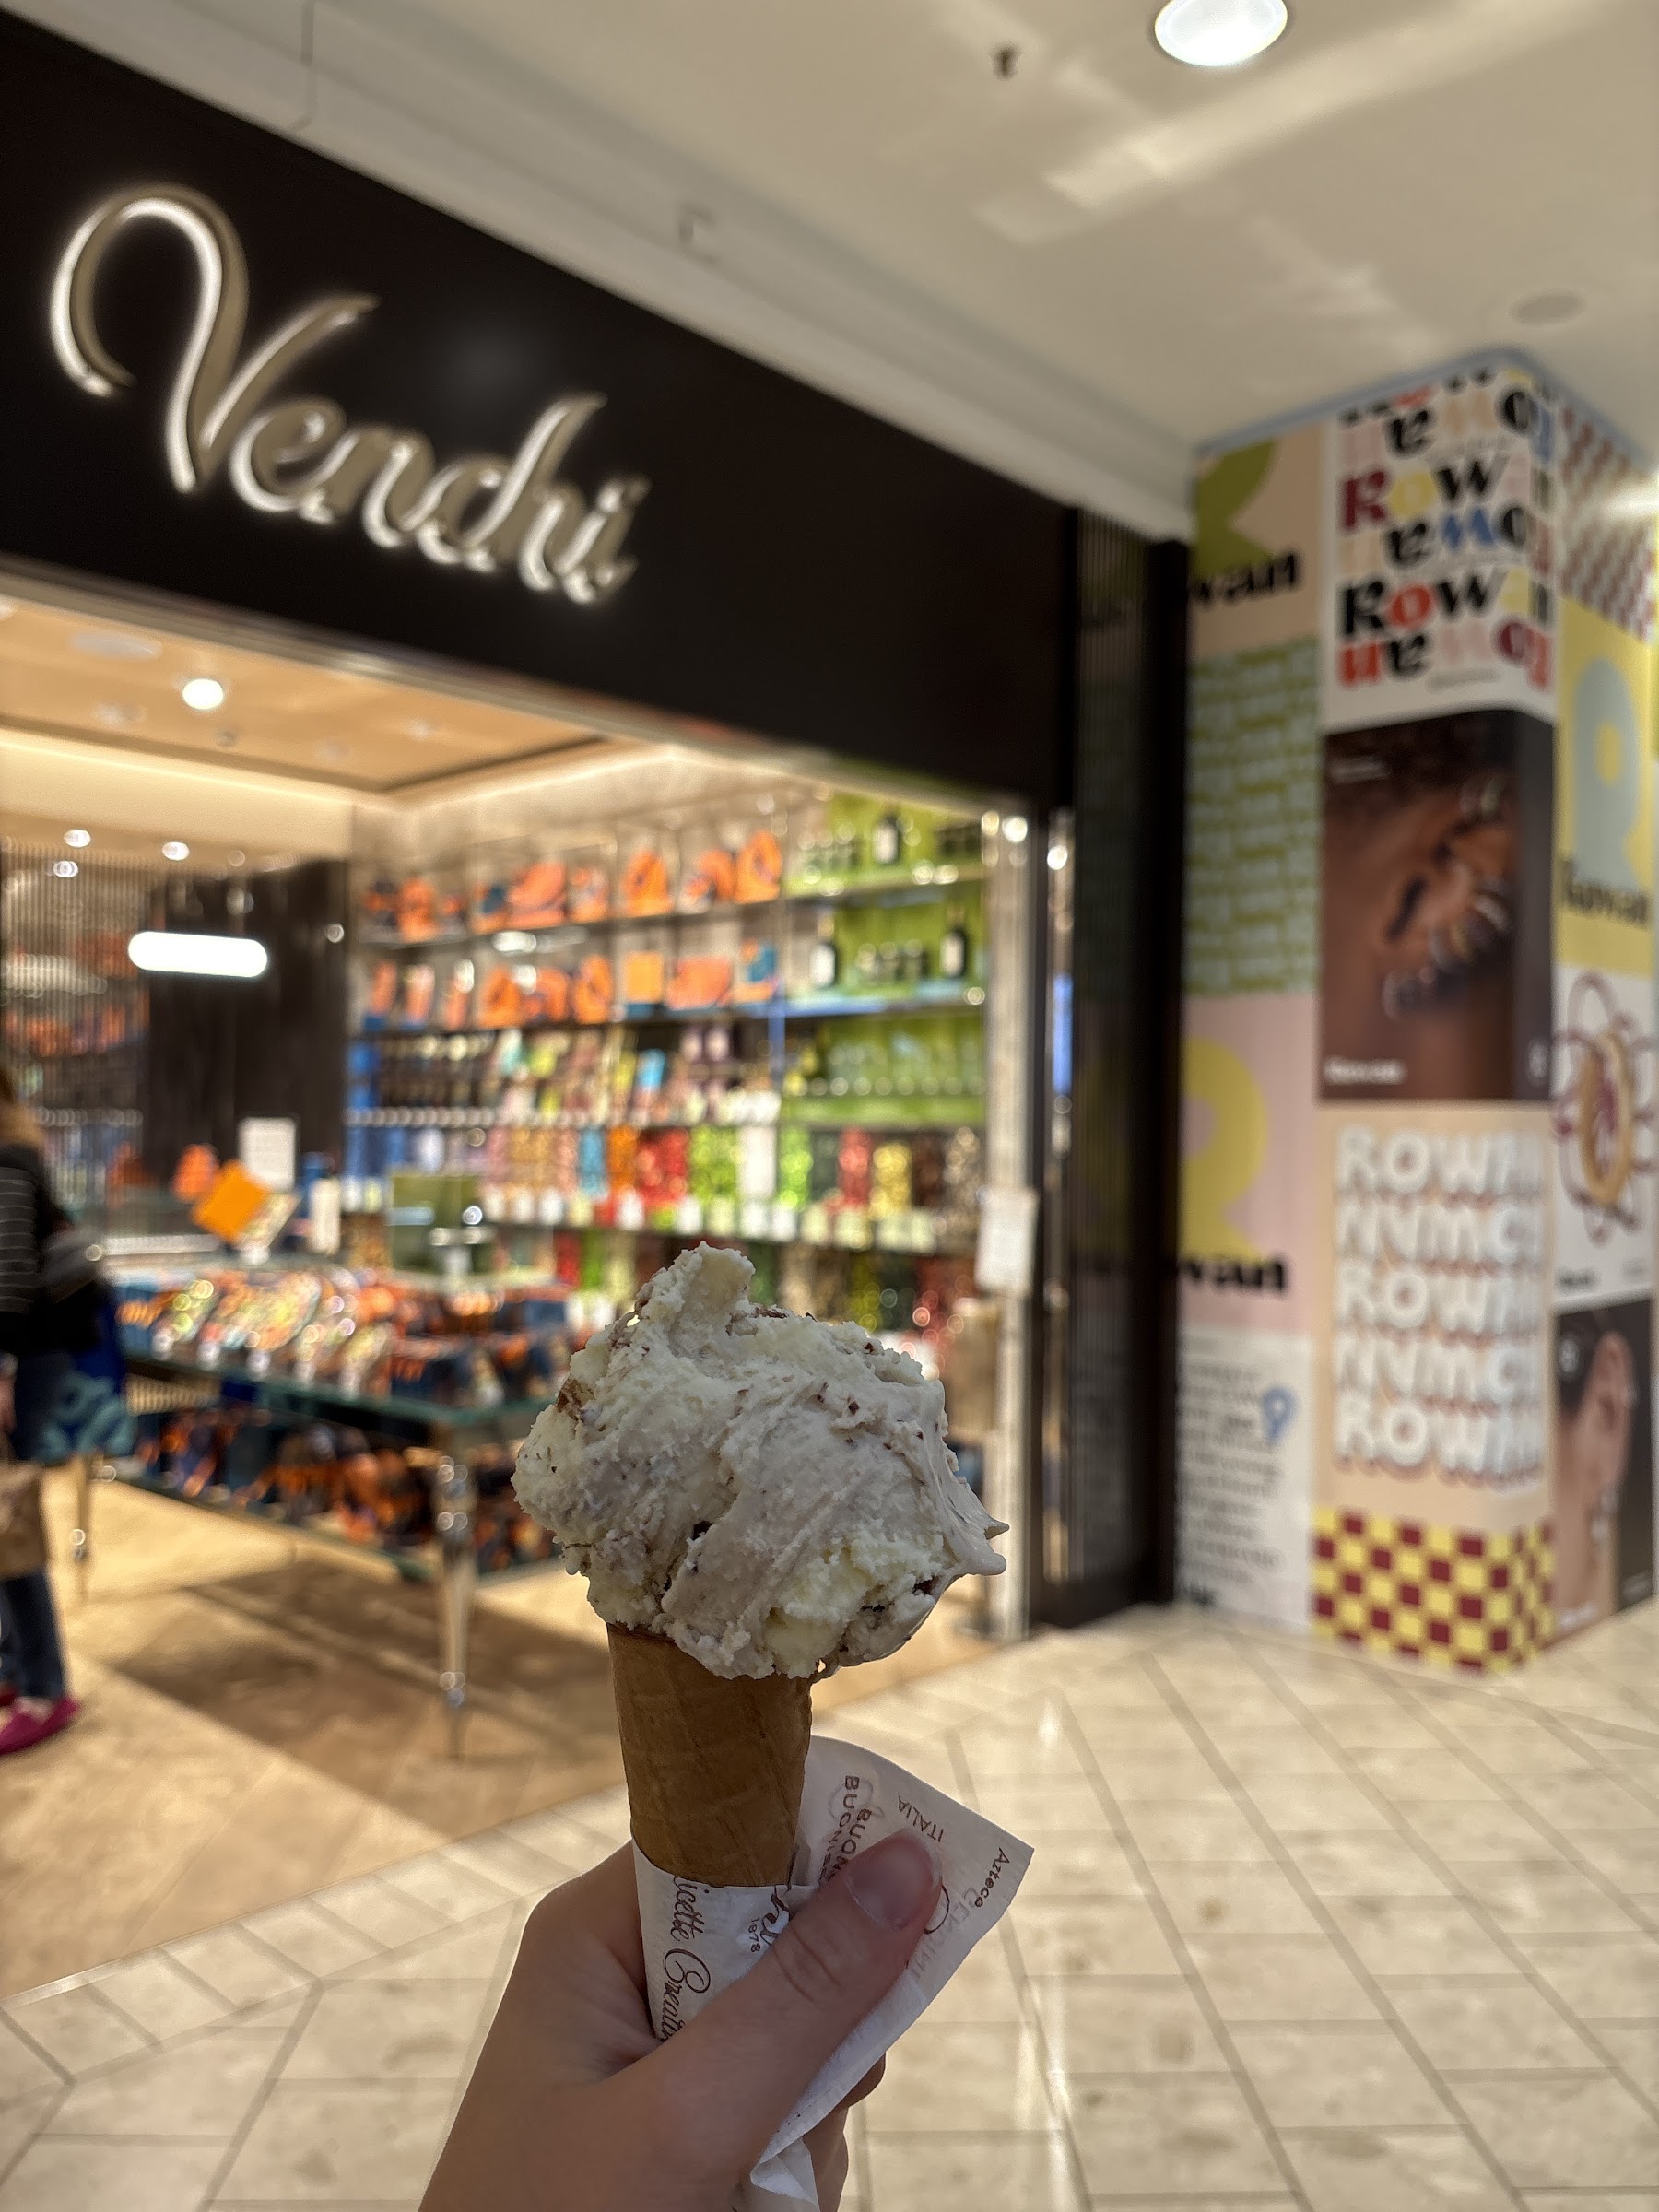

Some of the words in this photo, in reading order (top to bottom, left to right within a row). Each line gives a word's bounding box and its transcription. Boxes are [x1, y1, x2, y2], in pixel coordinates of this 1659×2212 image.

[46, 180, 651, 606] Venchi
[898, 1794, 945, 1843] ITALIA
[671, 1876, 710, 1941] icette
